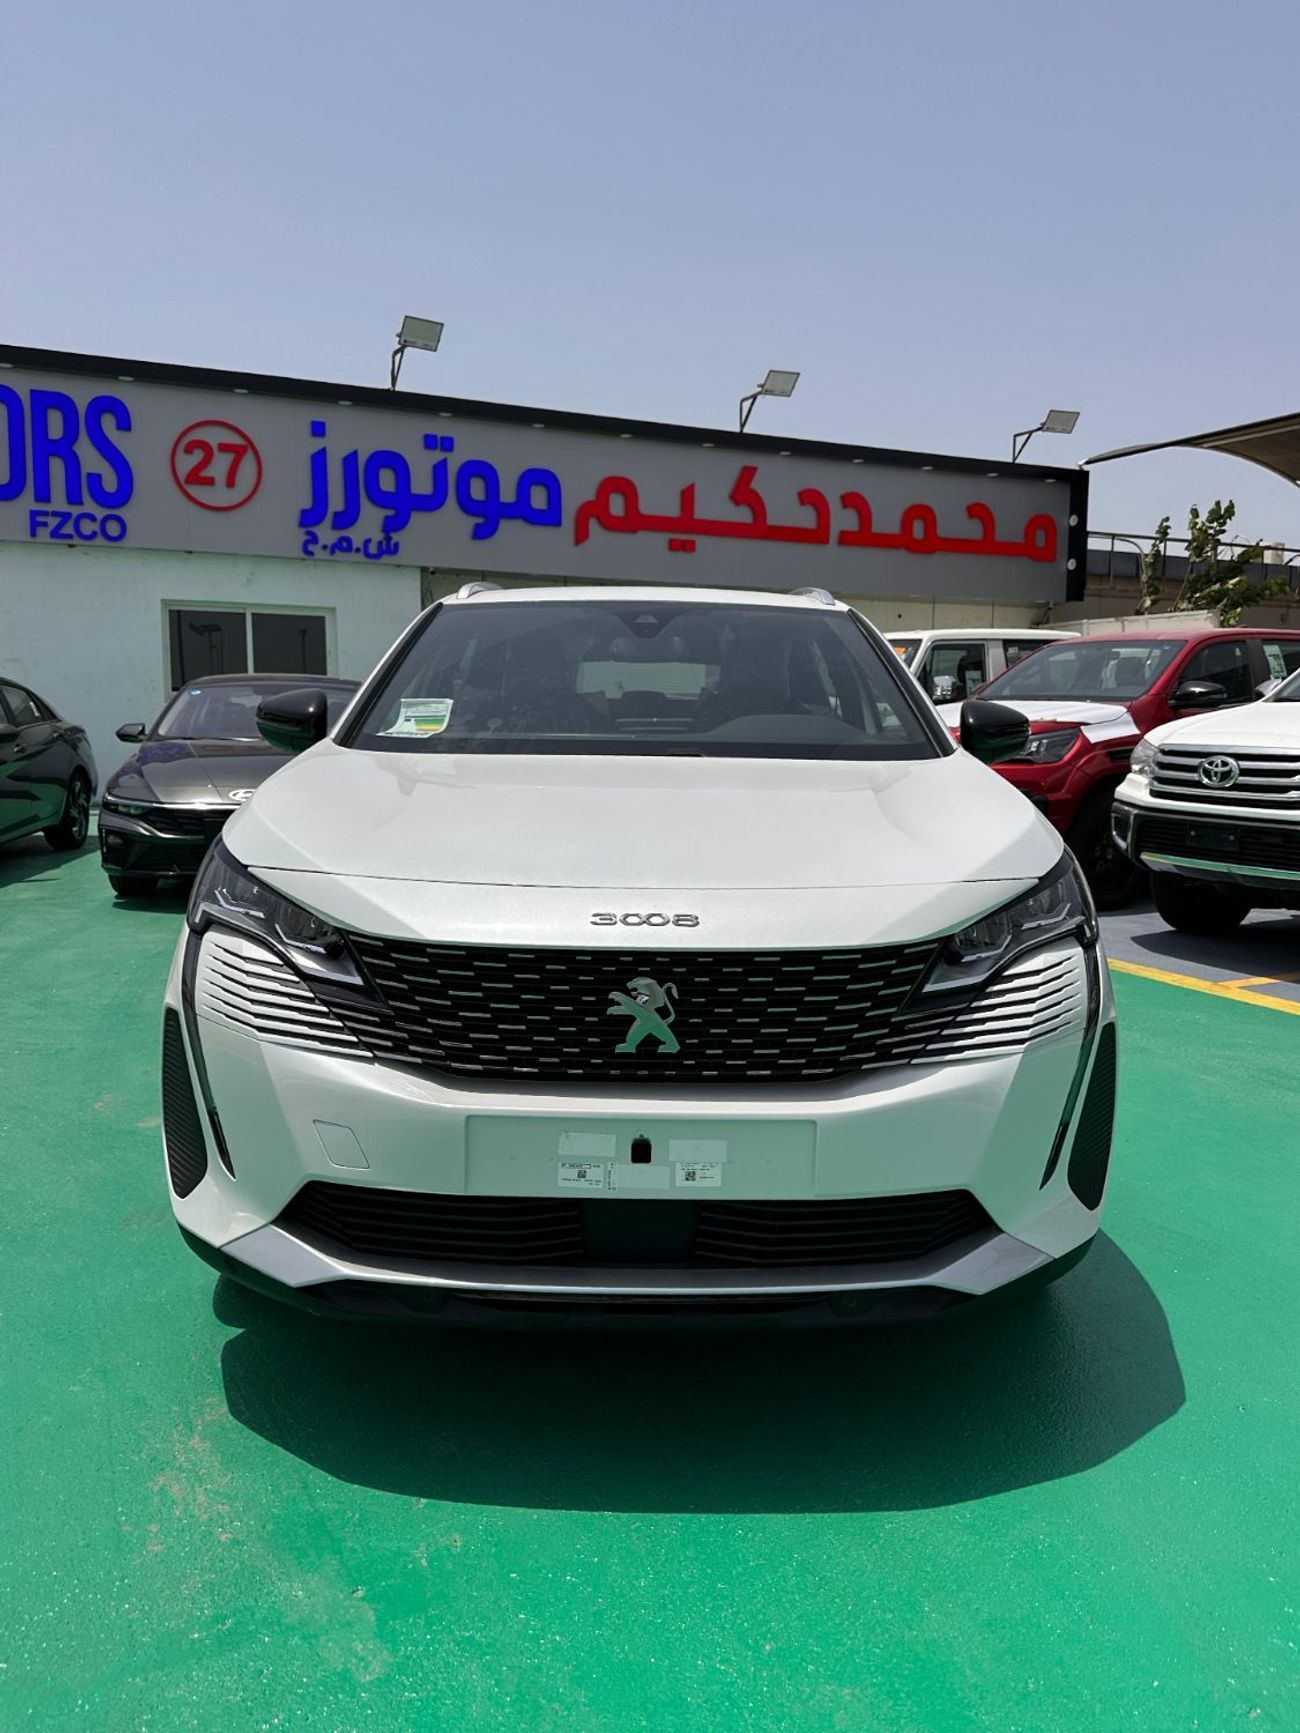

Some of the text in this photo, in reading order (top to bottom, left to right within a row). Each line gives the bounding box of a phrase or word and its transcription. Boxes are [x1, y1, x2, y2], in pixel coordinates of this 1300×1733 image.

[182, 437, 250, 489] 27
[297, 418, 1058, 563] محمد حكيم موتورز
[28, 508, 128, 543] FZCO
[589, 912, 701, 928] 3008
